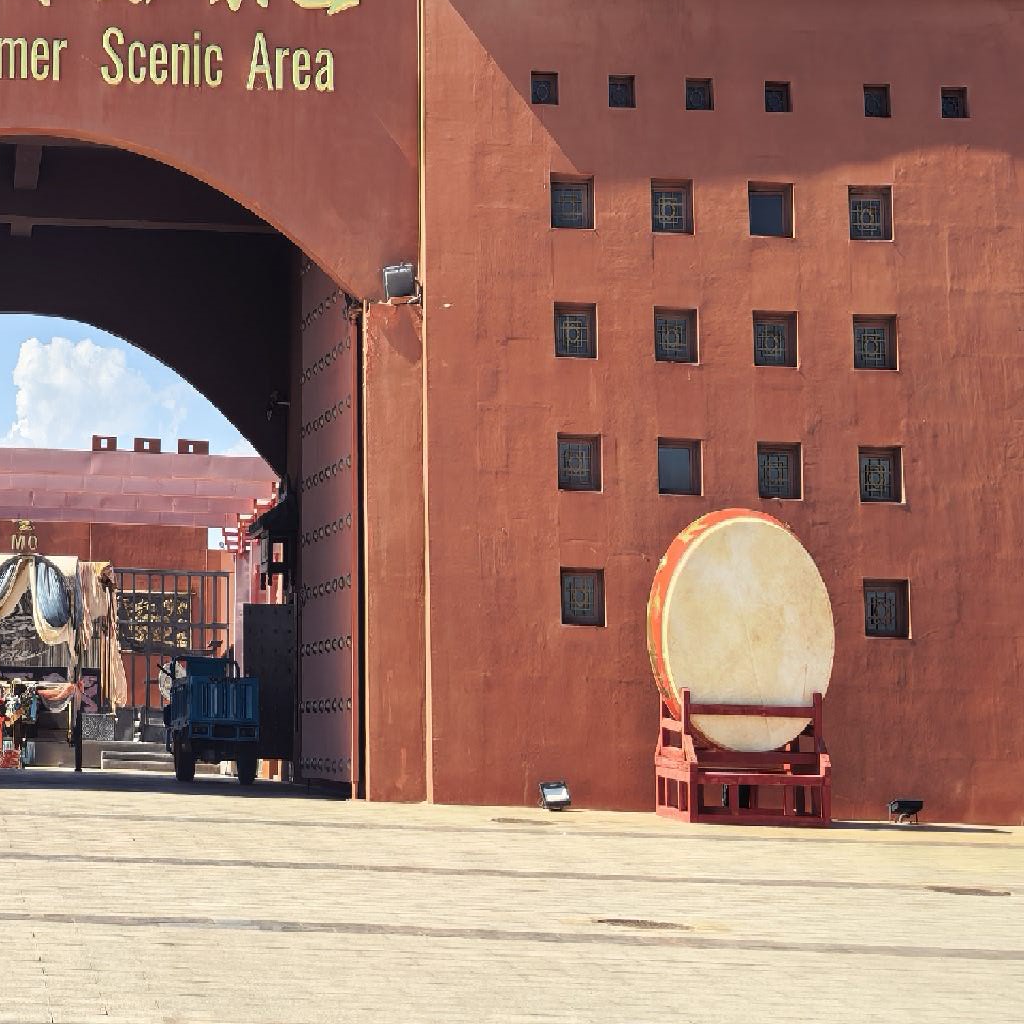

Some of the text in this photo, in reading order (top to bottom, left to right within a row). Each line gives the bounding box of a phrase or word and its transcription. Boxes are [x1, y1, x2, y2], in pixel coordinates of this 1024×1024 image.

[101, 26, 223, 88] Scenic
[246, 32, 335, 92] Area
[11, 534, 38, 551] MO
